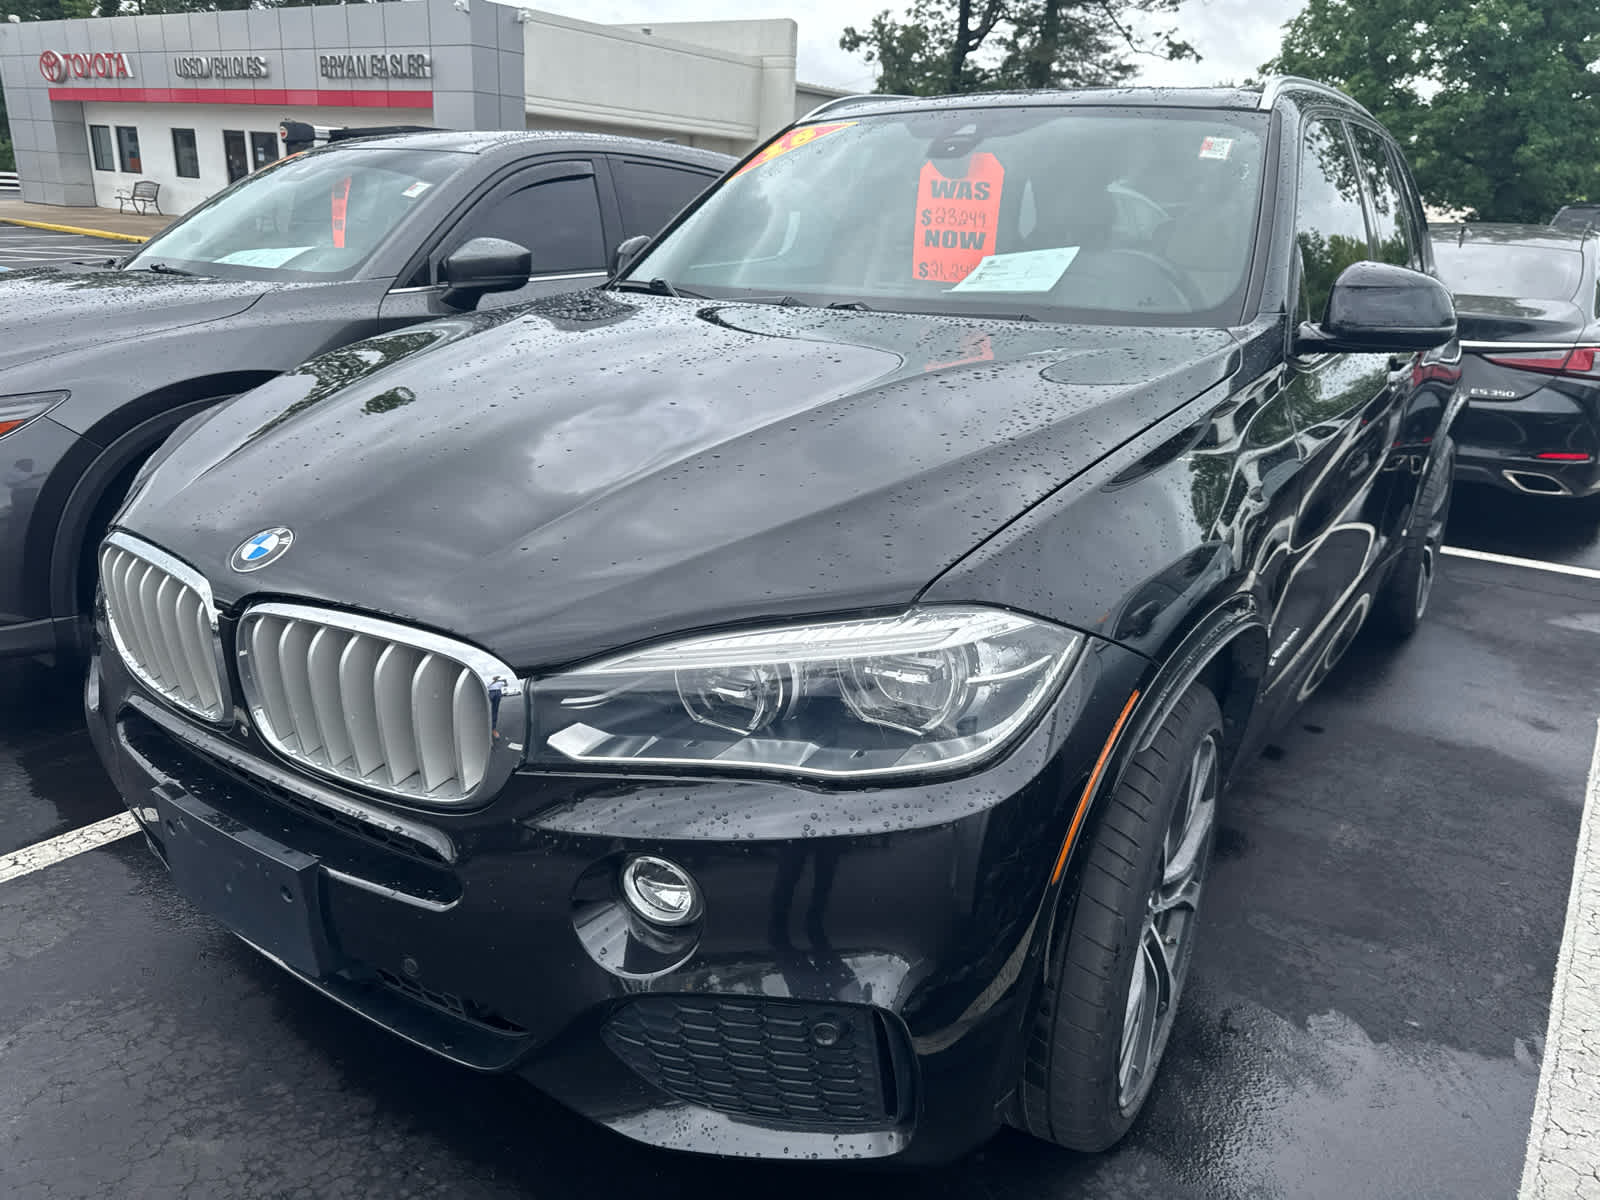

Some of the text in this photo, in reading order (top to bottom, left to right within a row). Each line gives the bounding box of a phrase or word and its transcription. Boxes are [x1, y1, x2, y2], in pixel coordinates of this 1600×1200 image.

[63, 53, 134, 79] TOYOTA
[174, 56, 268, 79] USED VEHICLES
[319, 54, 430, 79] BRYAN EASLER
[930, 180, 991, 201] WAS
[924, 229, 987, 250] NOW
